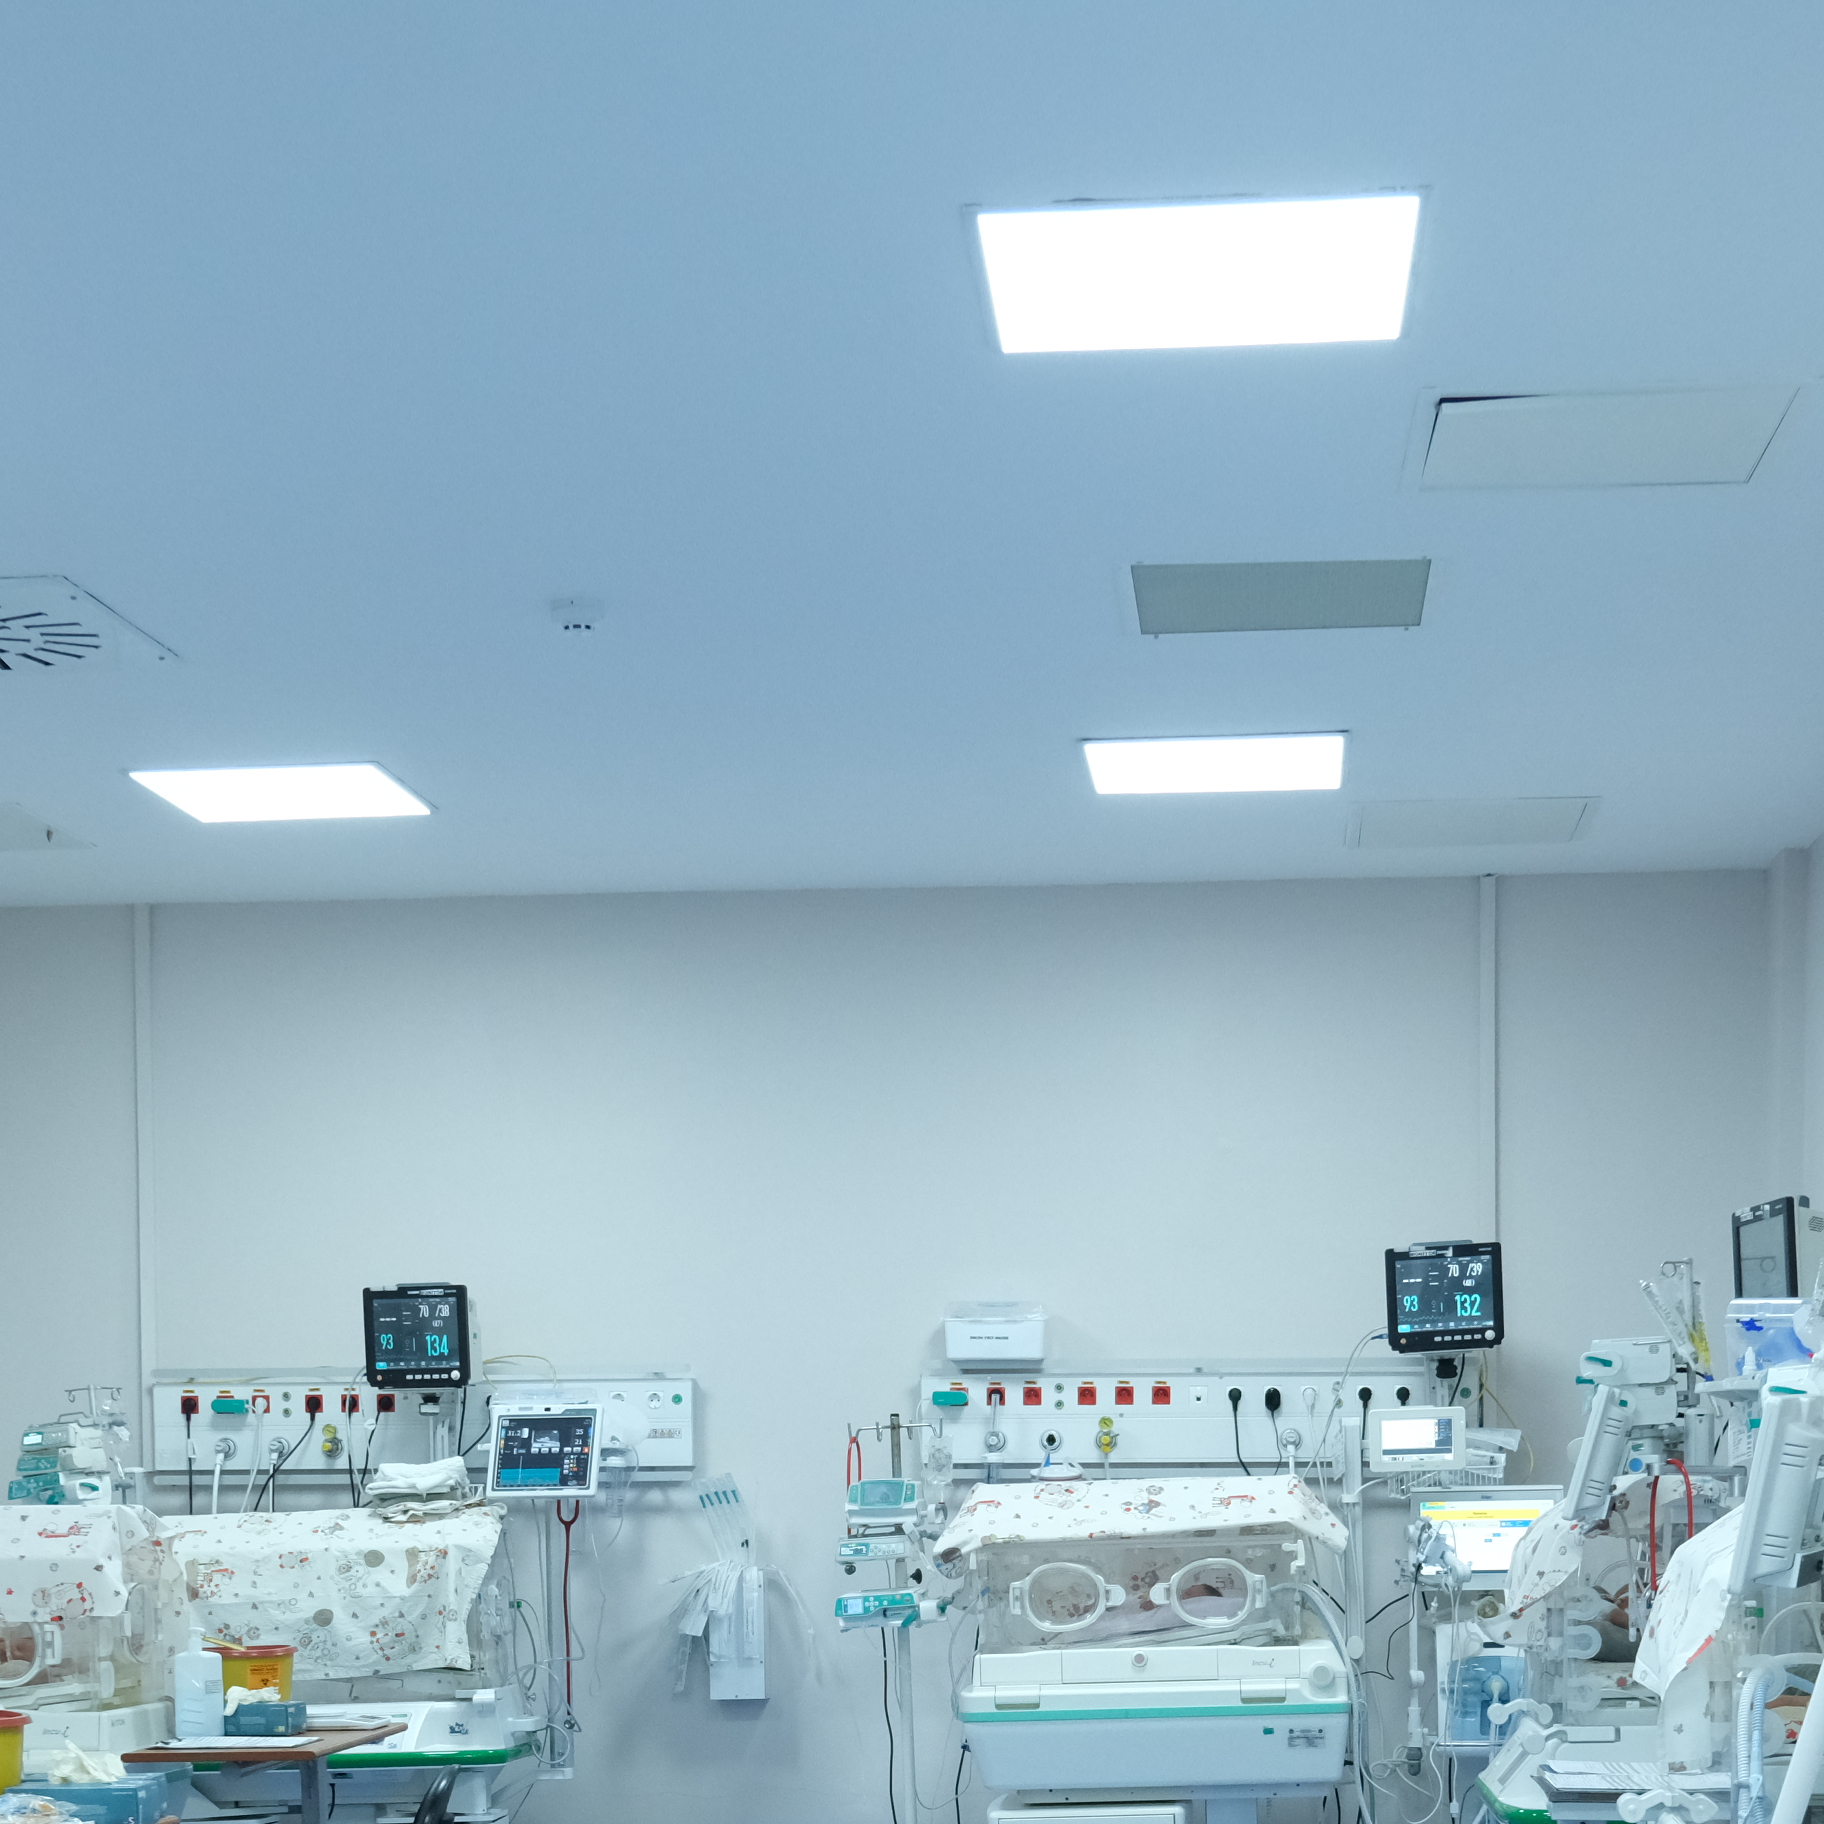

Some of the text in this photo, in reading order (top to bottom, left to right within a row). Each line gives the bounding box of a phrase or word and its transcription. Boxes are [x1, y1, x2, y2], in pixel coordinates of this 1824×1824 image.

[1447, 1262, 1483, 1277] 70 /39
[418, 1304, 429, 1318] 70
[1403, 1295, 1419, 1312] 93
[1455, 1294, 1482, 1317] 132
[380, 1333, 393, 1350] 93
[426, 1334, 449, 1356] 134
